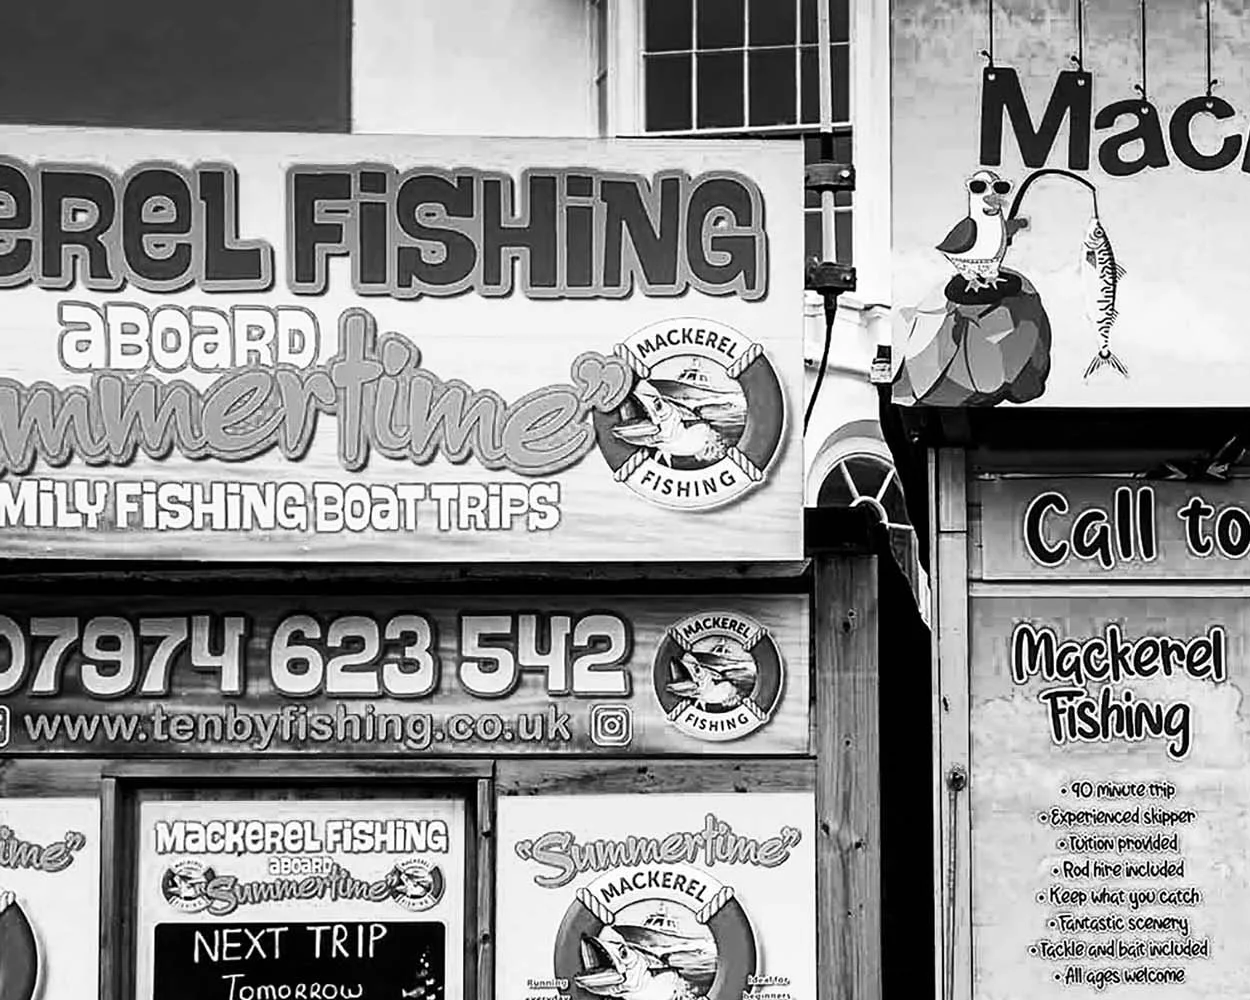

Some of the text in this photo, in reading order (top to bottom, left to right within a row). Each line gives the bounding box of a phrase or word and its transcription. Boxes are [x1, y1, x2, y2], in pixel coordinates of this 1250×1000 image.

[635, 327, 738, 359] MACKEREL
[641, 469, 737, 498] FISHING
[1024, 486, 1156, 567] Call
[682, 617, 753, 640] MACKEREL
[269, 614, 437, 697] 623
[458, 613, 633, 698] 542
[1013, 624, 1225, 686] Mackerel
[24, 703, 573, 750] www.tenbyfishing.co.uk
[684, 713, 750, 733] FISHING
[1040, 687, 1190, 759] Fishing
[1071, 781, 1176, 801] 90 minute trip
[1051, 808, 1197, 830] Experienced skipper
[1068, 835, 1178, 855] Tuition provided
[1063, 861, 1185, 878] Rod hire included
[599, 869, 709, 904] MACKEREL
[1050, 887, 1200, 910] Keep what you catch
[1058, 914, 1189, 937] Fantastic scenery
[193, 923, 388, 964] NEXT TRIP
[1040, 940, 1209, 958] Tackle and bait included
[1065, 966, 1186, 990] All ages welcome
